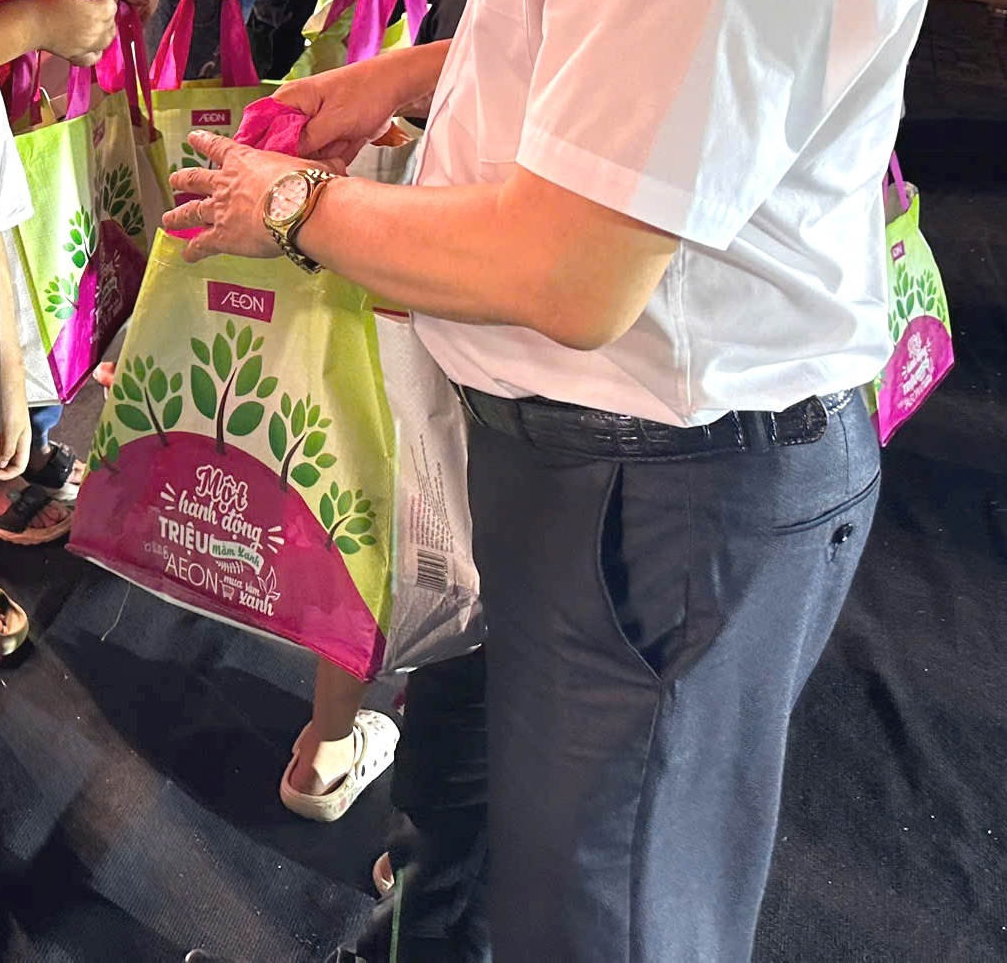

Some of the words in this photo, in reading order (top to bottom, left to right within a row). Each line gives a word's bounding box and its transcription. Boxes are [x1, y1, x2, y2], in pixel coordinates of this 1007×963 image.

[195, 464, 248, 514] Một
[158, 515, 209, 556] TRIỆU
[178, 490, 218, 525] hành
[221, 509, 264, 552] động
[165, 553, 218, 595] AEON
